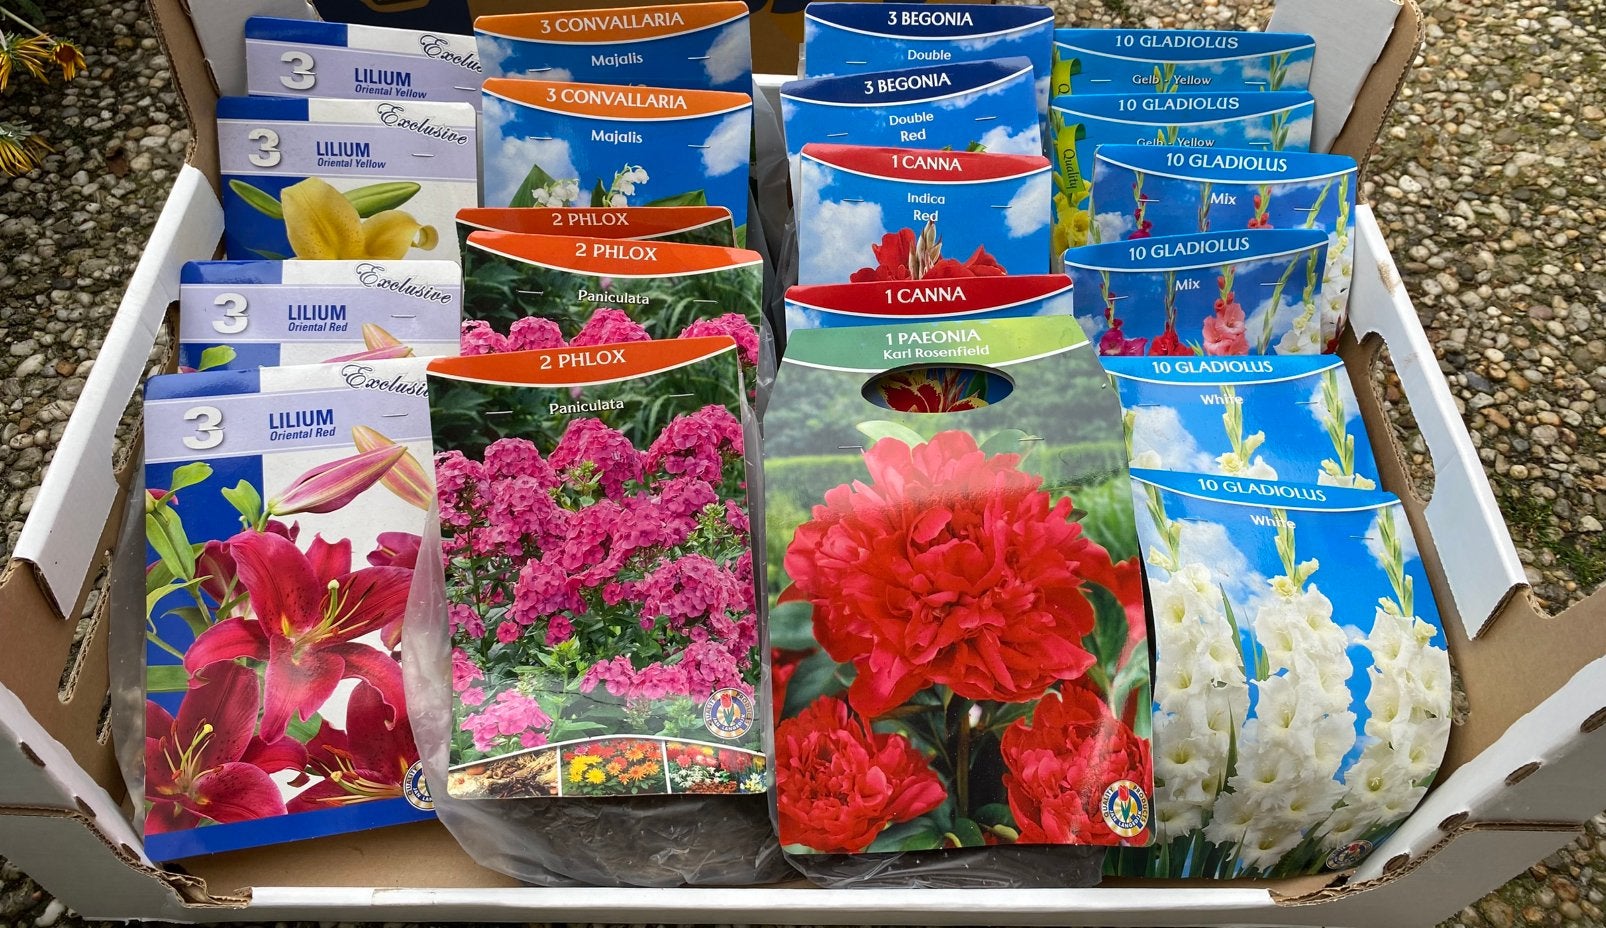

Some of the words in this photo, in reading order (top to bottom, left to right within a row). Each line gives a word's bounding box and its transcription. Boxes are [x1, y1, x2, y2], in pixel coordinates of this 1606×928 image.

[540, 20, 551, 34] 3
[555, 13, 685, 33] CONVALLARIA
[887, 11, 898, 26] 3
[901, 11, 973, 26] BEGONIA
[1115, 34, 1134, 48] 10
[1139, 34, 1239, 50] GLADIOLUS
[591, 52, 644, 67] Majalis
[907, 49, 951, 61] Double
[280, 51, 316, 90] 3
[354, 68, 412, 88] LILIUM
[864, 81, 875, 95] 3
[878, 72, 951, 93] BEGONIA
[1132, 74, 1160, 85] Gelb
[1173, 75, 1212, 86] Yellow
[355, 84, 393, 97] Oriental
[394, 87, 428, 99] Yellow
[546, 88, 557, 102] 3
[561, 89, 687, 110] CONVALLARIA
[1118, 98, 1137, 111] 10
[1142, 97, 1240, 111] GLADIOLUS
[377, 102, 468, 145] Exclusive
[889, 112, 934, 126] Double
[591, 129, 643, 145] Majalis
[900, 129, 926, 143] Red
[1177, 137, 1215, 147] Yellow
[248, 128, 282, 167] 3
[316, 141, 371, 158] LILIUM
[317, 157, 353, 169] Oriental
[355, 158, 386, 169] Yellow
[892, 155, 899, 169] 1
[902, 155, 962, 171] CANNA
[1063, 149, 1080, 189] Quality
[1166, 153, 1184, 167] 10
[1188, 154, 1288, 172] GLADIOLUS
[907, 192, 945, 205] Indica
[1210, 192, 1237, 206] Mix
[552, 212, 563, 226] 2
[567, 212, 630, 226] PHLOX
[913, 209, 939, 222] Red
[575, 243, 587, 257] 2
[592, 244, 658, 261] PHLOX
[1128, 246, 1147, 261] 10
[1150, 237, 1250, 259] GLADIOLUS
[355, 262, 452, 305] Exclusive
[1175, 278, 1200, 292] Mix
[578, 289, 650, 305] Paniculata
[885, 288, 893, 304] 1
[897, 286, 967, 303] CANNA
[212, 293, 249, 334] 3
[288, 305, 347, 321] LILIUM
[288, 322, 327, 332] Oriental
[328, 321, 348, 332] Red
[886, 332, 893, 346] 1
[898, 328, 982, 345] PAEONIA
[540, 355, 552, 369] 2
[558, 349, 627, 369] PHLOX
[883, 348, 912, 360] Karl
[915, 345, 990, 359] Rosenfield
[1151, 361, 1170, 375] 10
[1174, 360, 1274, 375] GLADIOLUS
[549, 399, 625, 415] Paniculata
[1200, 393, 1244, 405] White
[269, 408, 334, 430] LILIUM
[182, 405, 224, 450] 3
[270, 428, 314, 441] Oriental
[315, 426, 336, 438] Red
[1197, 478, 1219, 492] 10
[1222, 481, 1327, 502] GLADIOLUS
[1250, 514, 1297, 530] White
[1102, 786, 1114, 818] QUALITY
[1133, 785, 1148, 823] PRODUCTS
